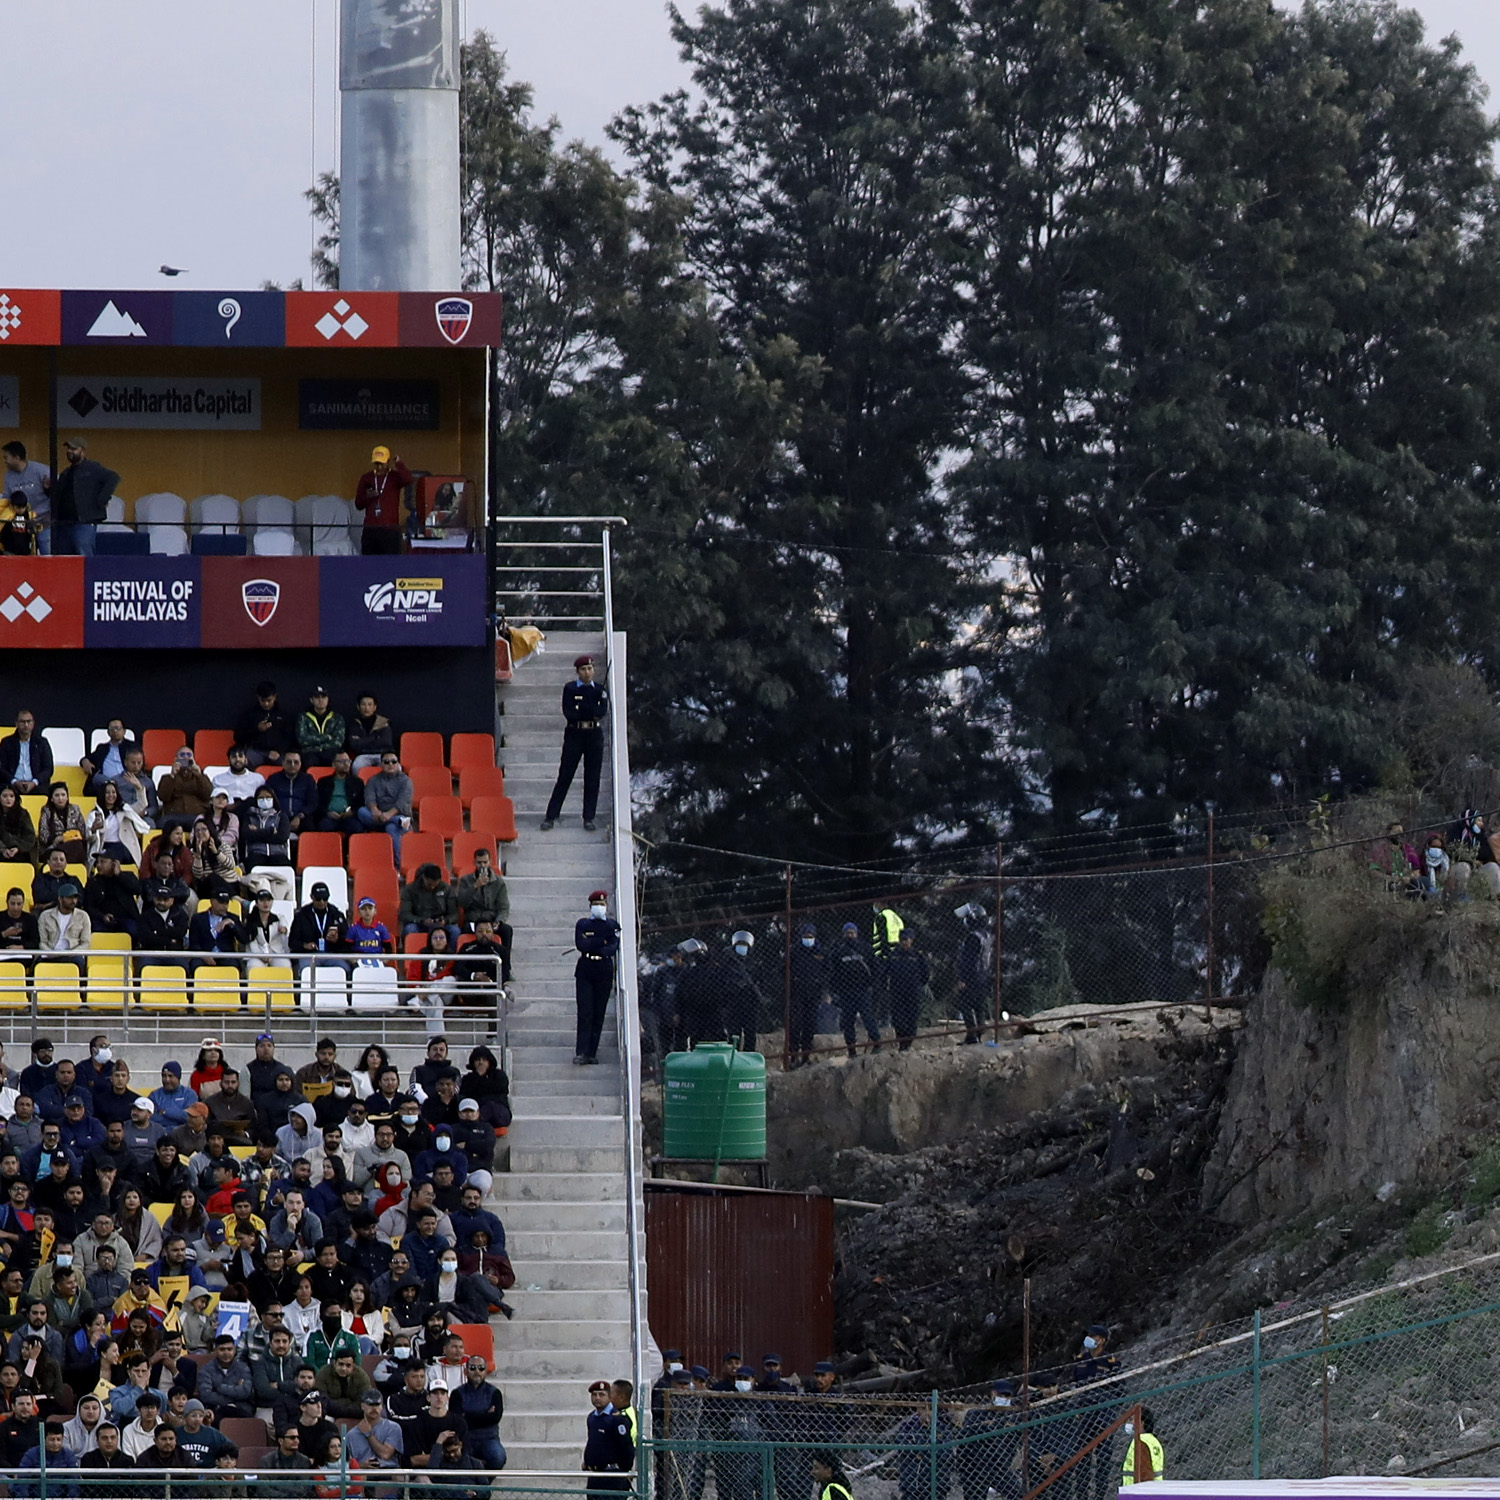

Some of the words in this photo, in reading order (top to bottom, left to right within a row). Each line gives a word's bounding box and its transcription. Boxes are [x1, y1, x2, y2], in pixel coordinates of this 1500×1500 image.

[93, 581, 168, 600] FESTIVAL
[171, 580, 194, 600] OF
[393, 590, 443, 609] NPL
[93, 601, 188, 621] HIMALAYAS
[221, 1314, 242, 1338] 4
